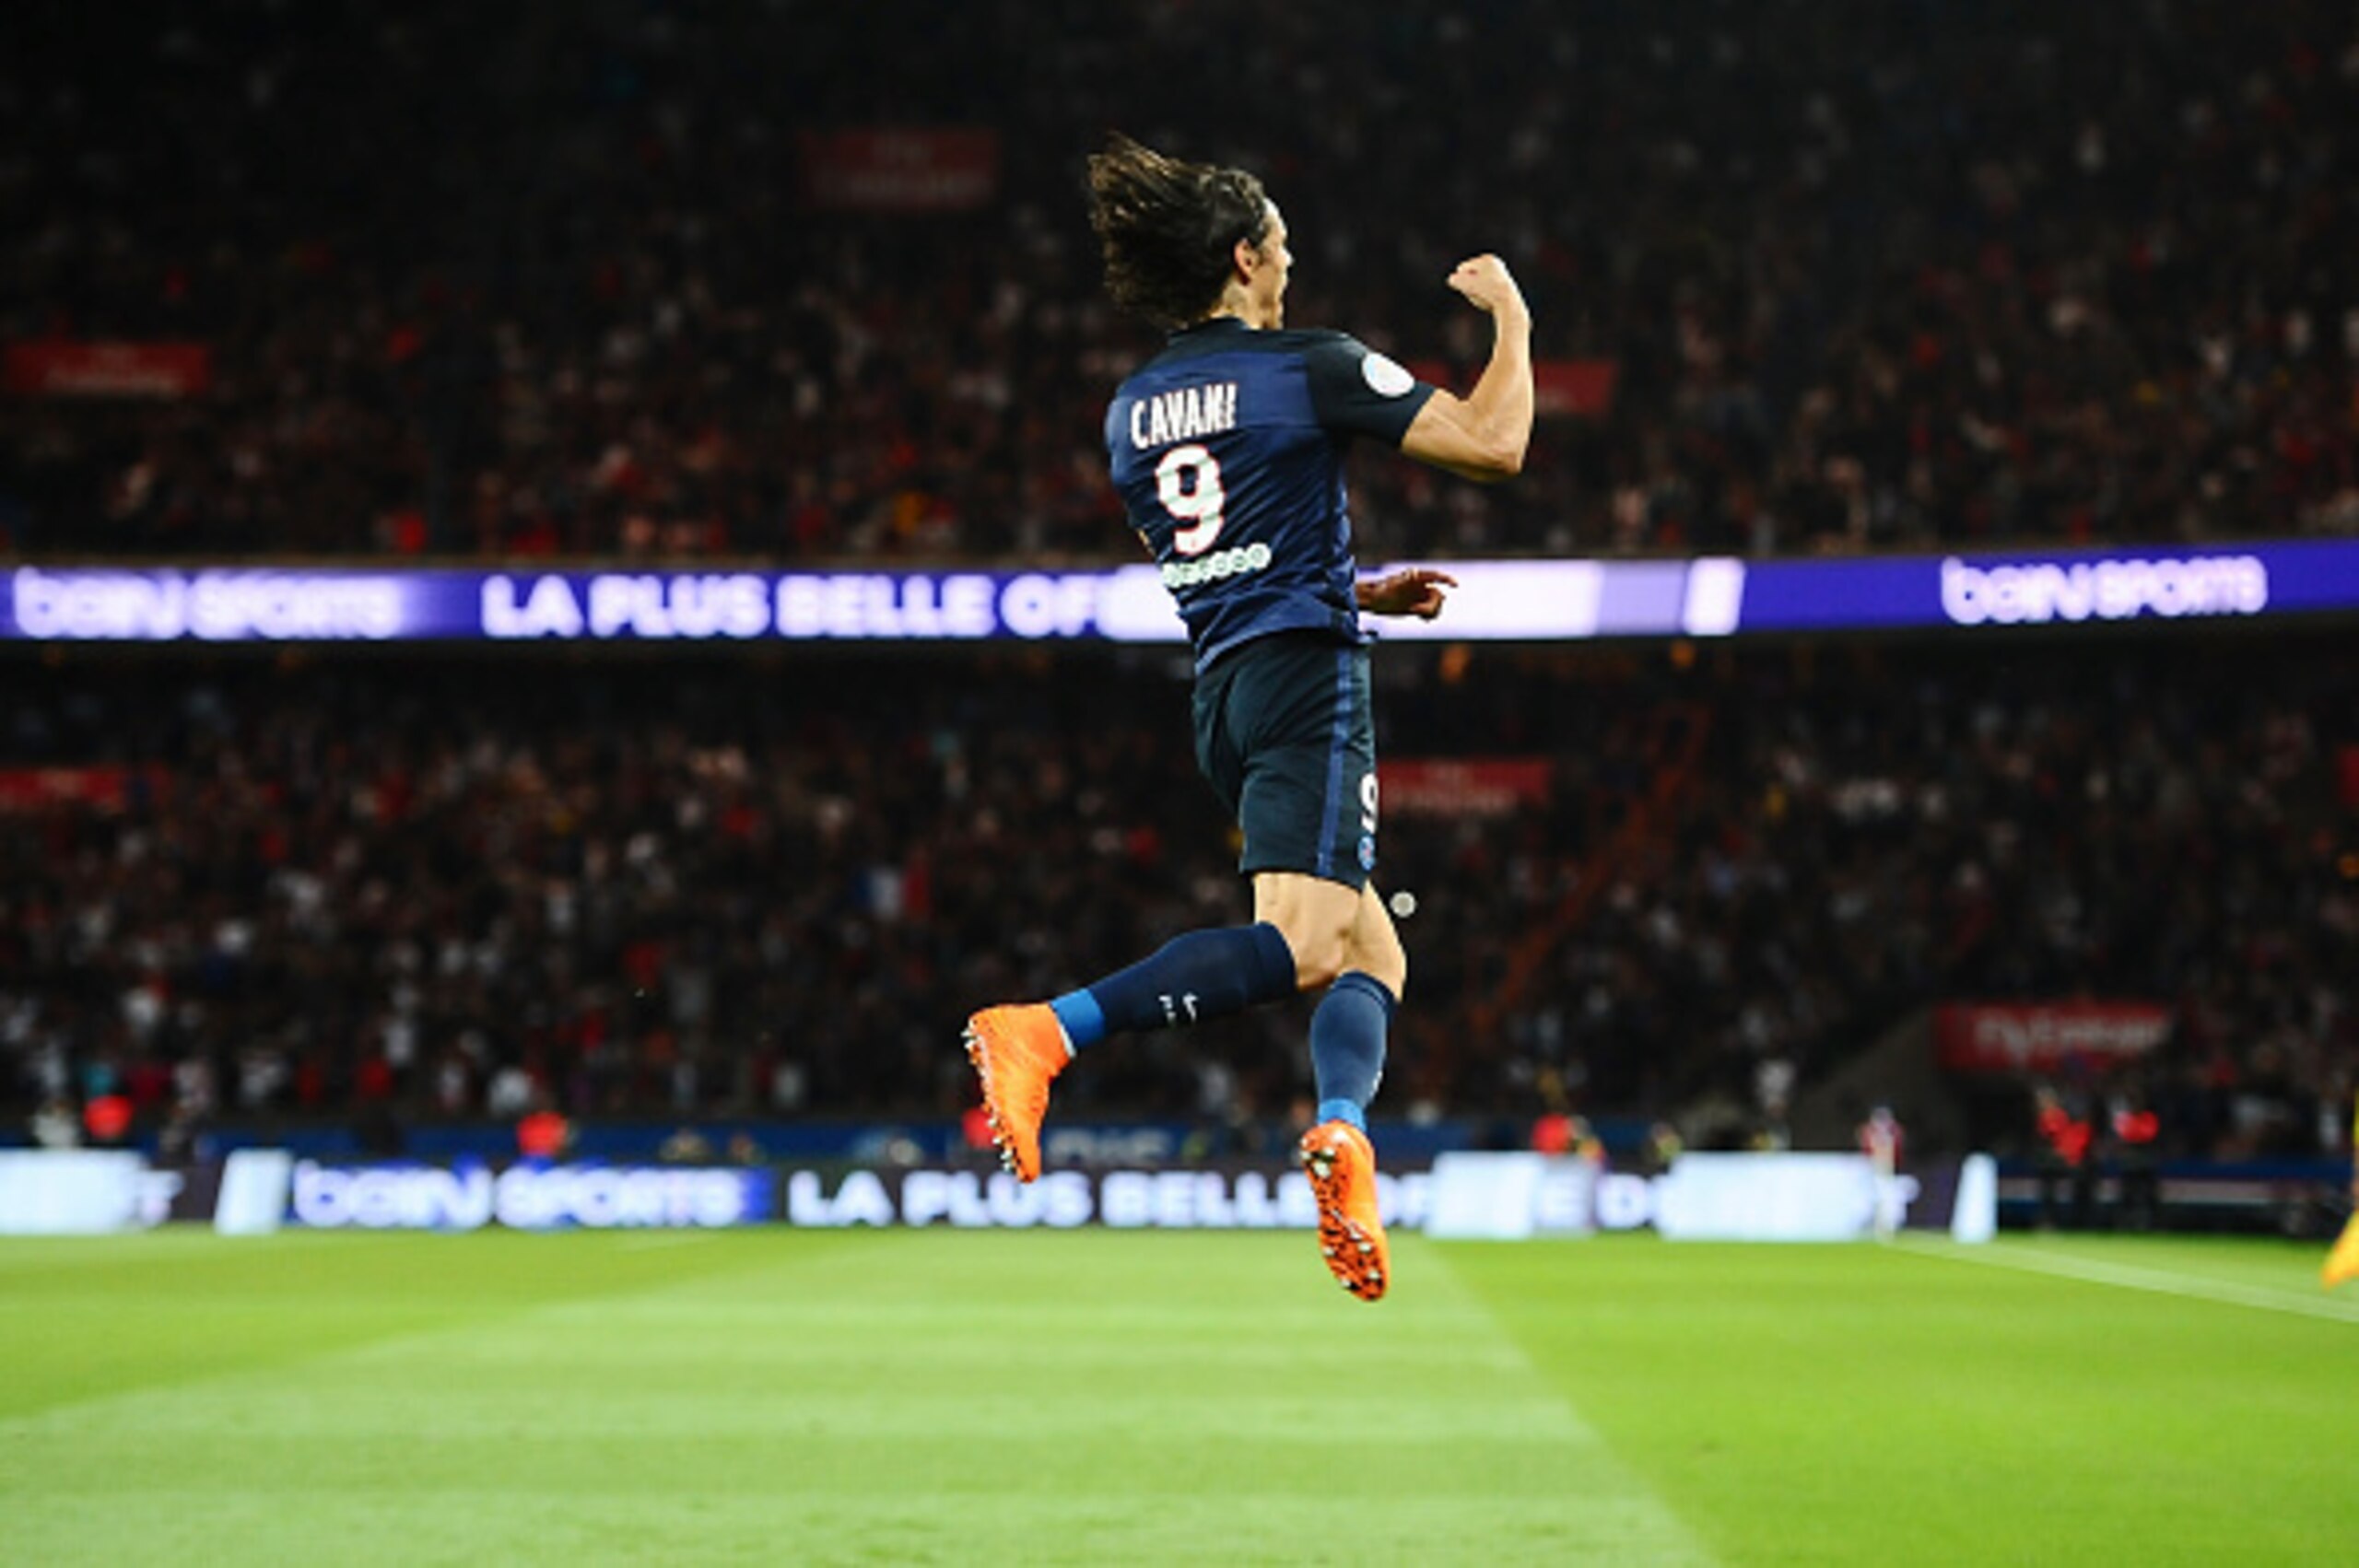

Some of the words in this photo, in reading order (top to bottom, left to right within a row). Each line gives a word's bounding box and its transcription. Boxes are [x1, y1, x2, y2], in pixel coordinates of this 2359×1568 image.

[1131, 380, 1237, 450] CAVANI
[1155, 443, 1226, 556] 9
[481, 574, 584, 638] LA
[588, 574, 771, 638] PLUS
[777, 574, 997, 638] BELLE
[788, 1170, 895, 1227] LA
[900, 1170, 1094, 1227] PLUS
